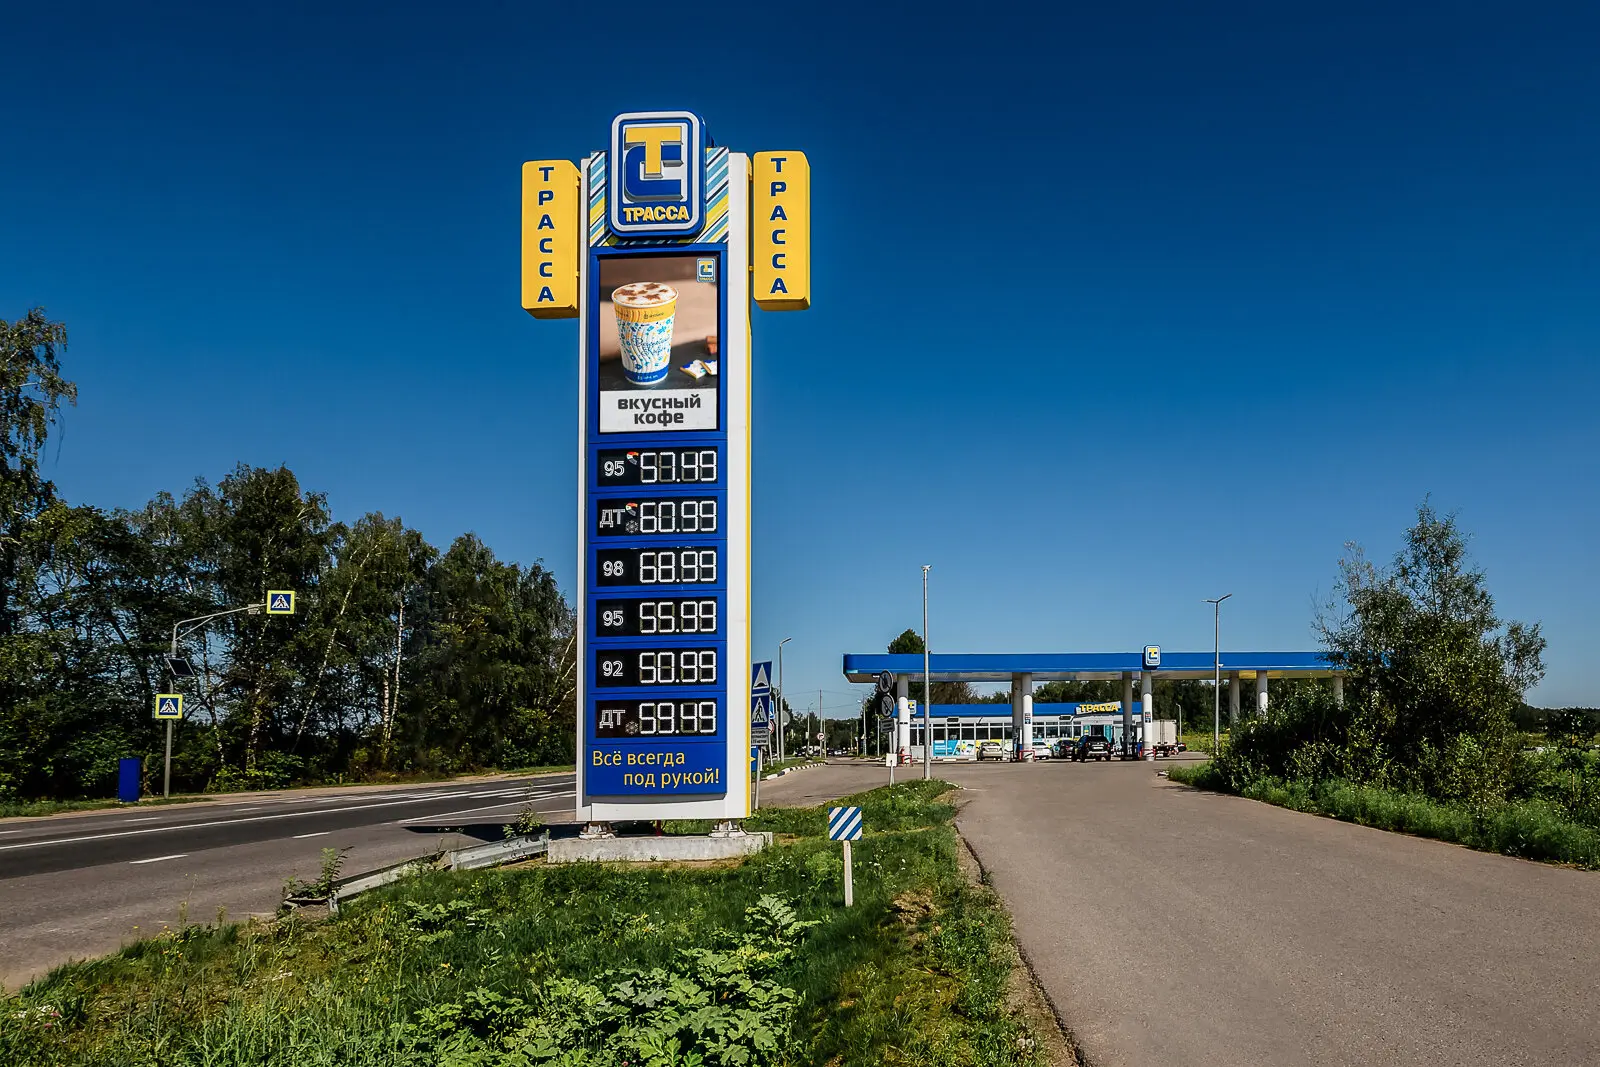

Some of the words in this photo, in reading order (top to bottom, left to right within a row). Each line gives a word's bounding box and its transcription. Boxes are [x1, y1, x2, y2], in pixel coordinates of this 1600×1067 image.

[623, 205, 690, 223] ТРАССА
[770, 157, 788, 294] ТРАССА
[537, 166, 555, 302] ТРАССА
[617, 393, 701, 412] вкусный
[634, 410, 684, 426] кофе
[603, 460, 625, 477] 95
[640, 451, 717, 483] 57.49
[599, 508, 626, 528] ДТ
[640, 500, 717, 533] 60.99
[602, 560, 624, 577] 98
[639, 550, 717, 583] 68.99
[602, 610, 624, 627] 95
[639, 601, 717, 633] 55.99
[602, 660, 624, 677] 92
[639, 651, 717, 683] 50.99
[599, 709, 626, 728] ДТ
[639, 701, 717, 734] 59.49
[1079, 703, 1120, 713] ТРАССА
[592, 750, 622, 766] Всё
[627, 751, 685, 767] всегда
[624, 772, 656, 788] под
[661, 768, 720, 789] рукой!
